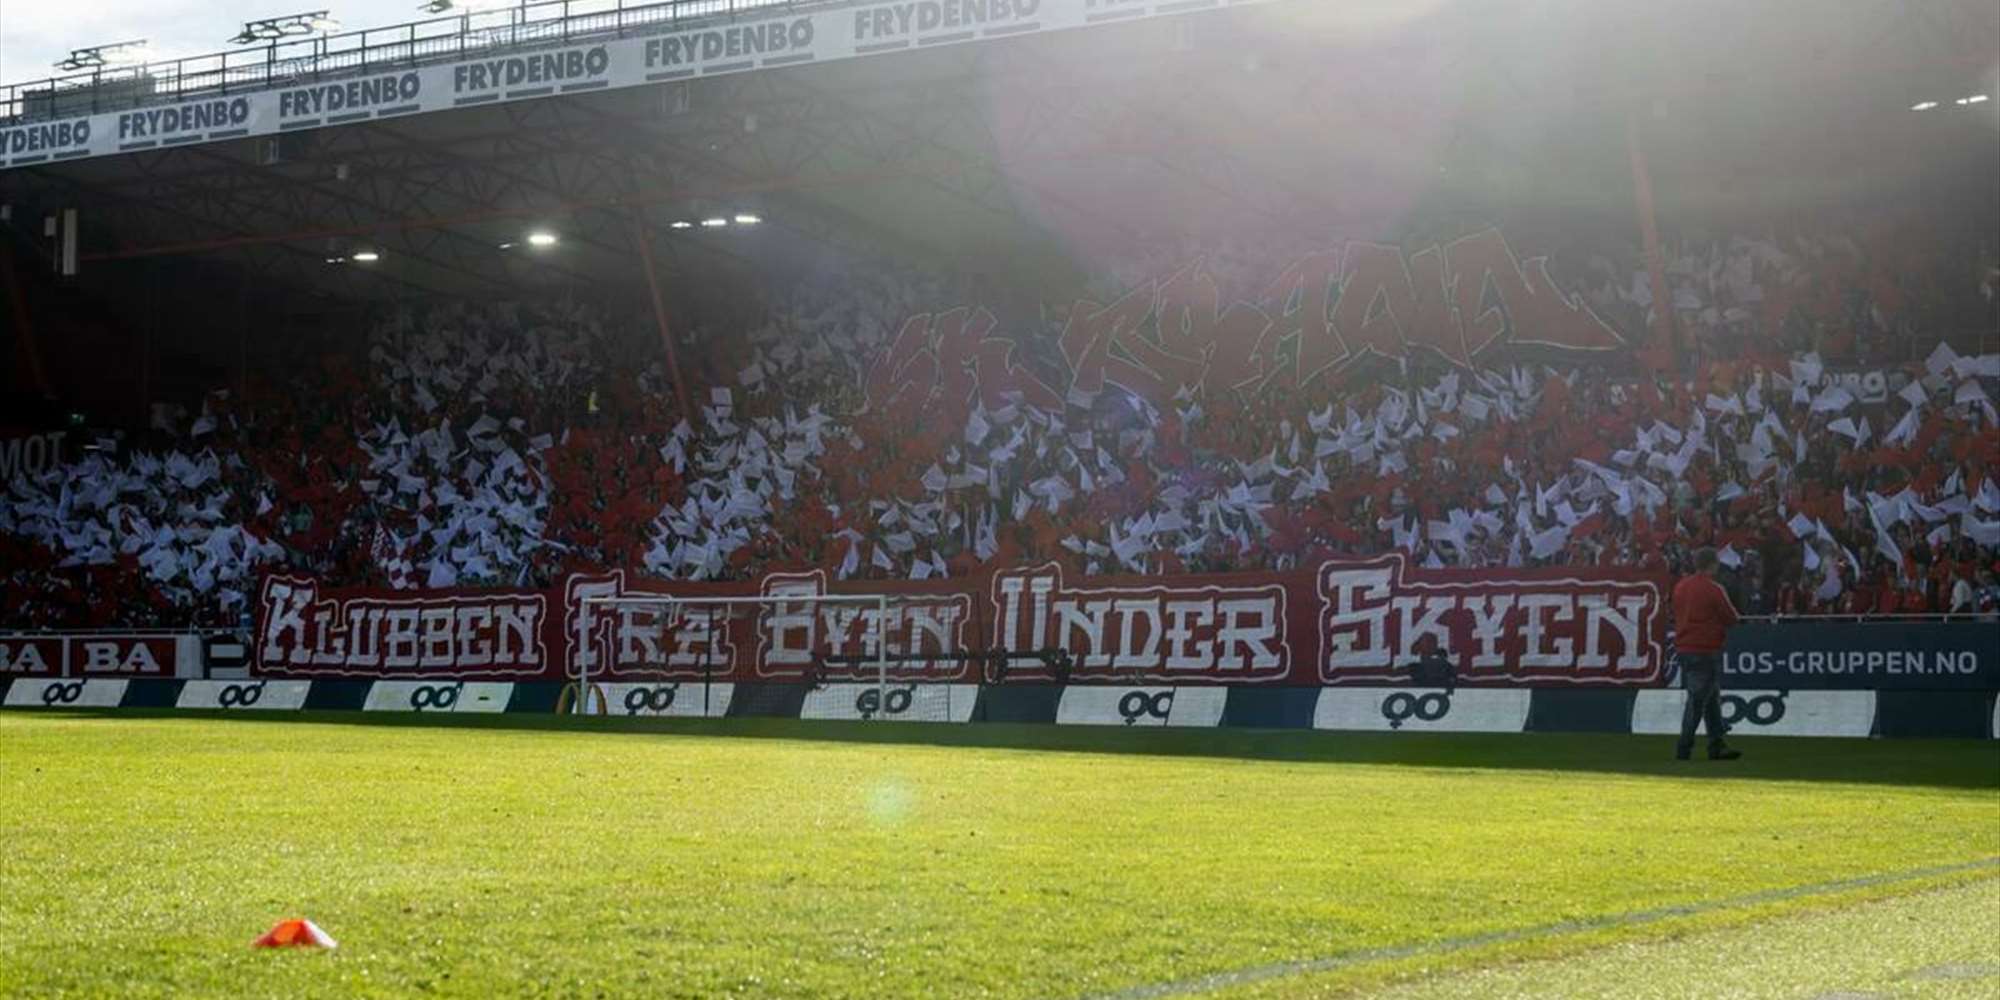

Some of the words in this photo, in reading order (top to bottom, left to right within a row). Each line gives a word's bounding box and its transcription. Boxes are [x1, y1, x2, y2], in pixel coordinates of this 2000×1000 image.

[645, 17, 815, 68] FRYDENBØ
[453, 44, 609, 94] FRYDENBØ
[279, 69, 420, 118] FRYDENBØ
[0, 120, 91, 155] YDENBØ
[118, 98, 249, 140] FRYDENBØ
[262, 582, 538, 669] KLUBBEN
[1000, 575, 1282, 671] UNDER
[1328, 565, 1650, 672] SKYEN
[0, 642, 49, 672] A
[83, 641, 161, 672] BA
[1722, 650, 1978, 675] LOS-GRUPPEN.NO
